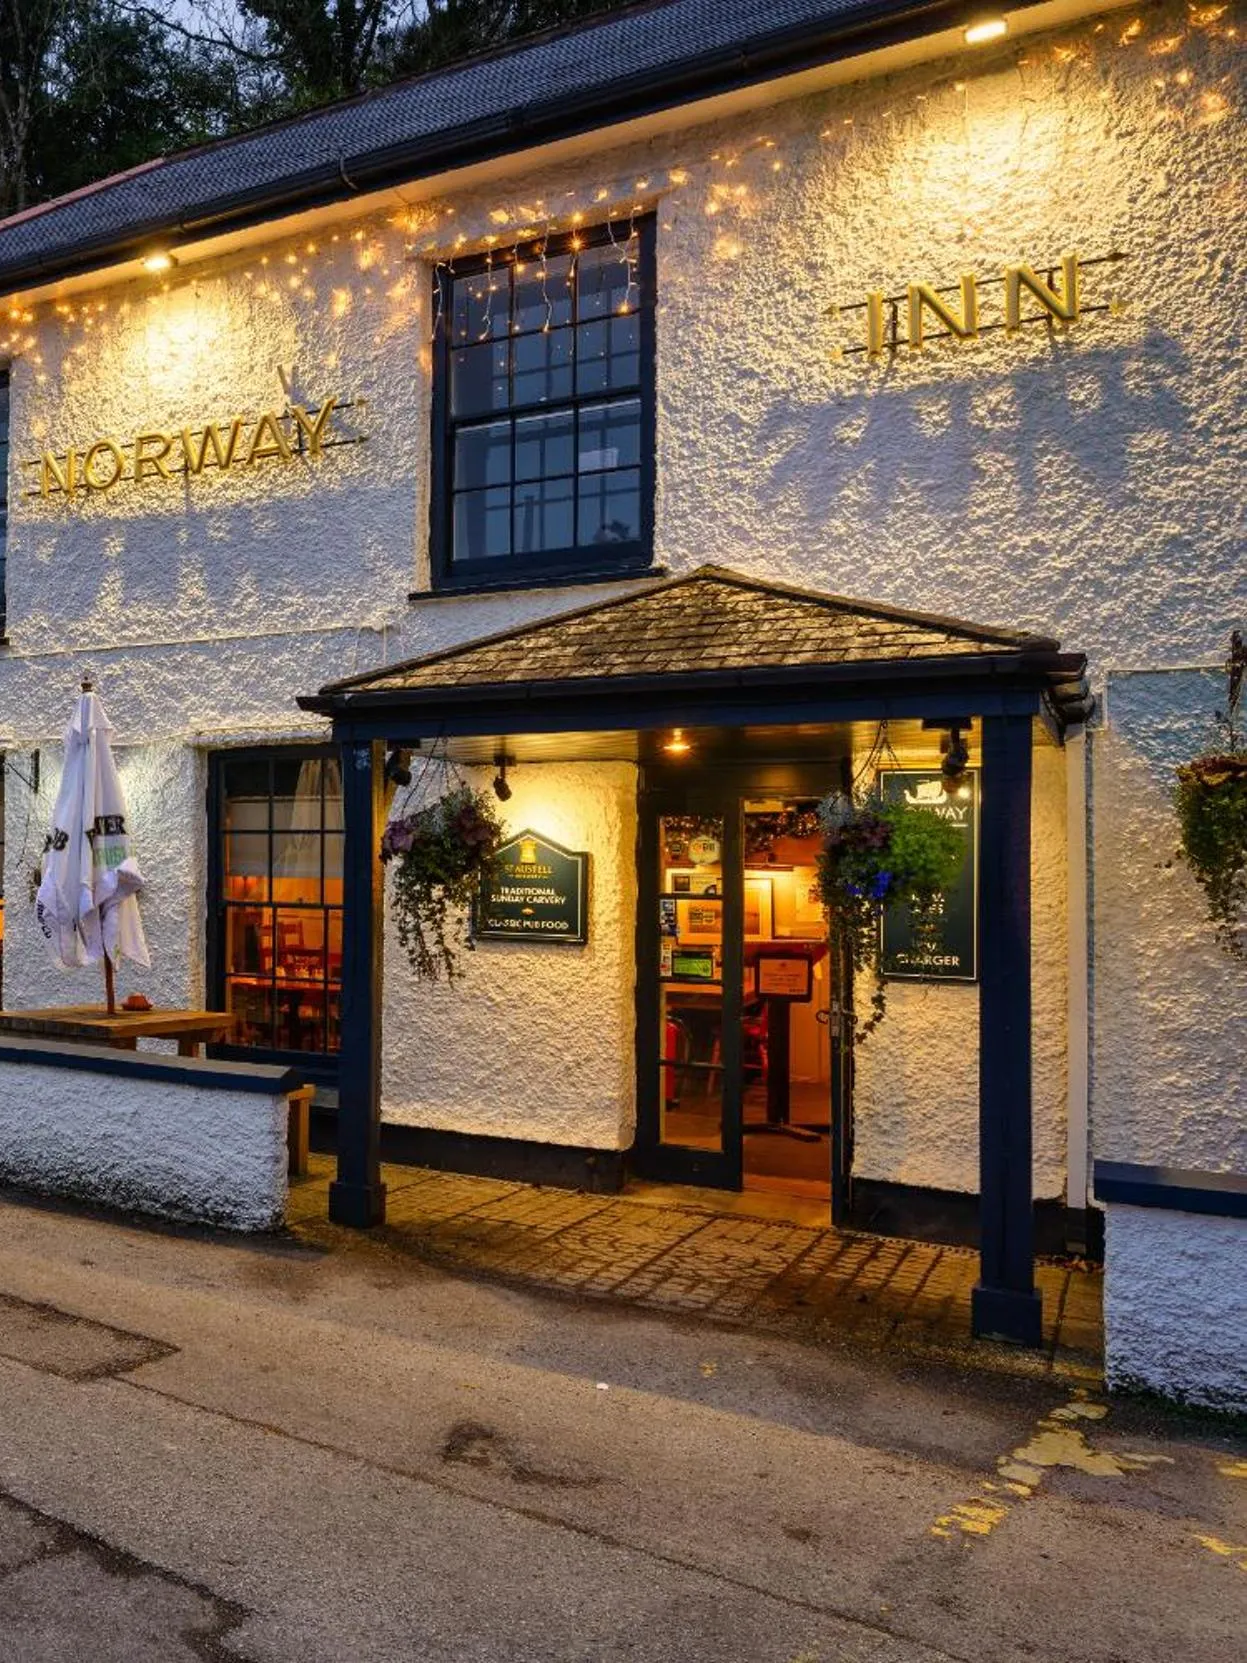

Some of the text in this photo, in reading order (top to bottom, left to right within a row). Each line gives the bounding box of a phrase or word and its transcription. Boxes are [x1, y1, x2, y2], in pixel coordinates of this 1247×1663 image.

[866, 253, 1080, 358] INN
[40, 397, 337, 501] NORWAY
[515, 865, 553, 874] AUSTELL
[501, 886, 555, 895] TRADITIONAL
[490, 895, 566, 905] SUNDAY CARVERY
[488, 919, 569, 930] CLASSIC PUB FOOD
